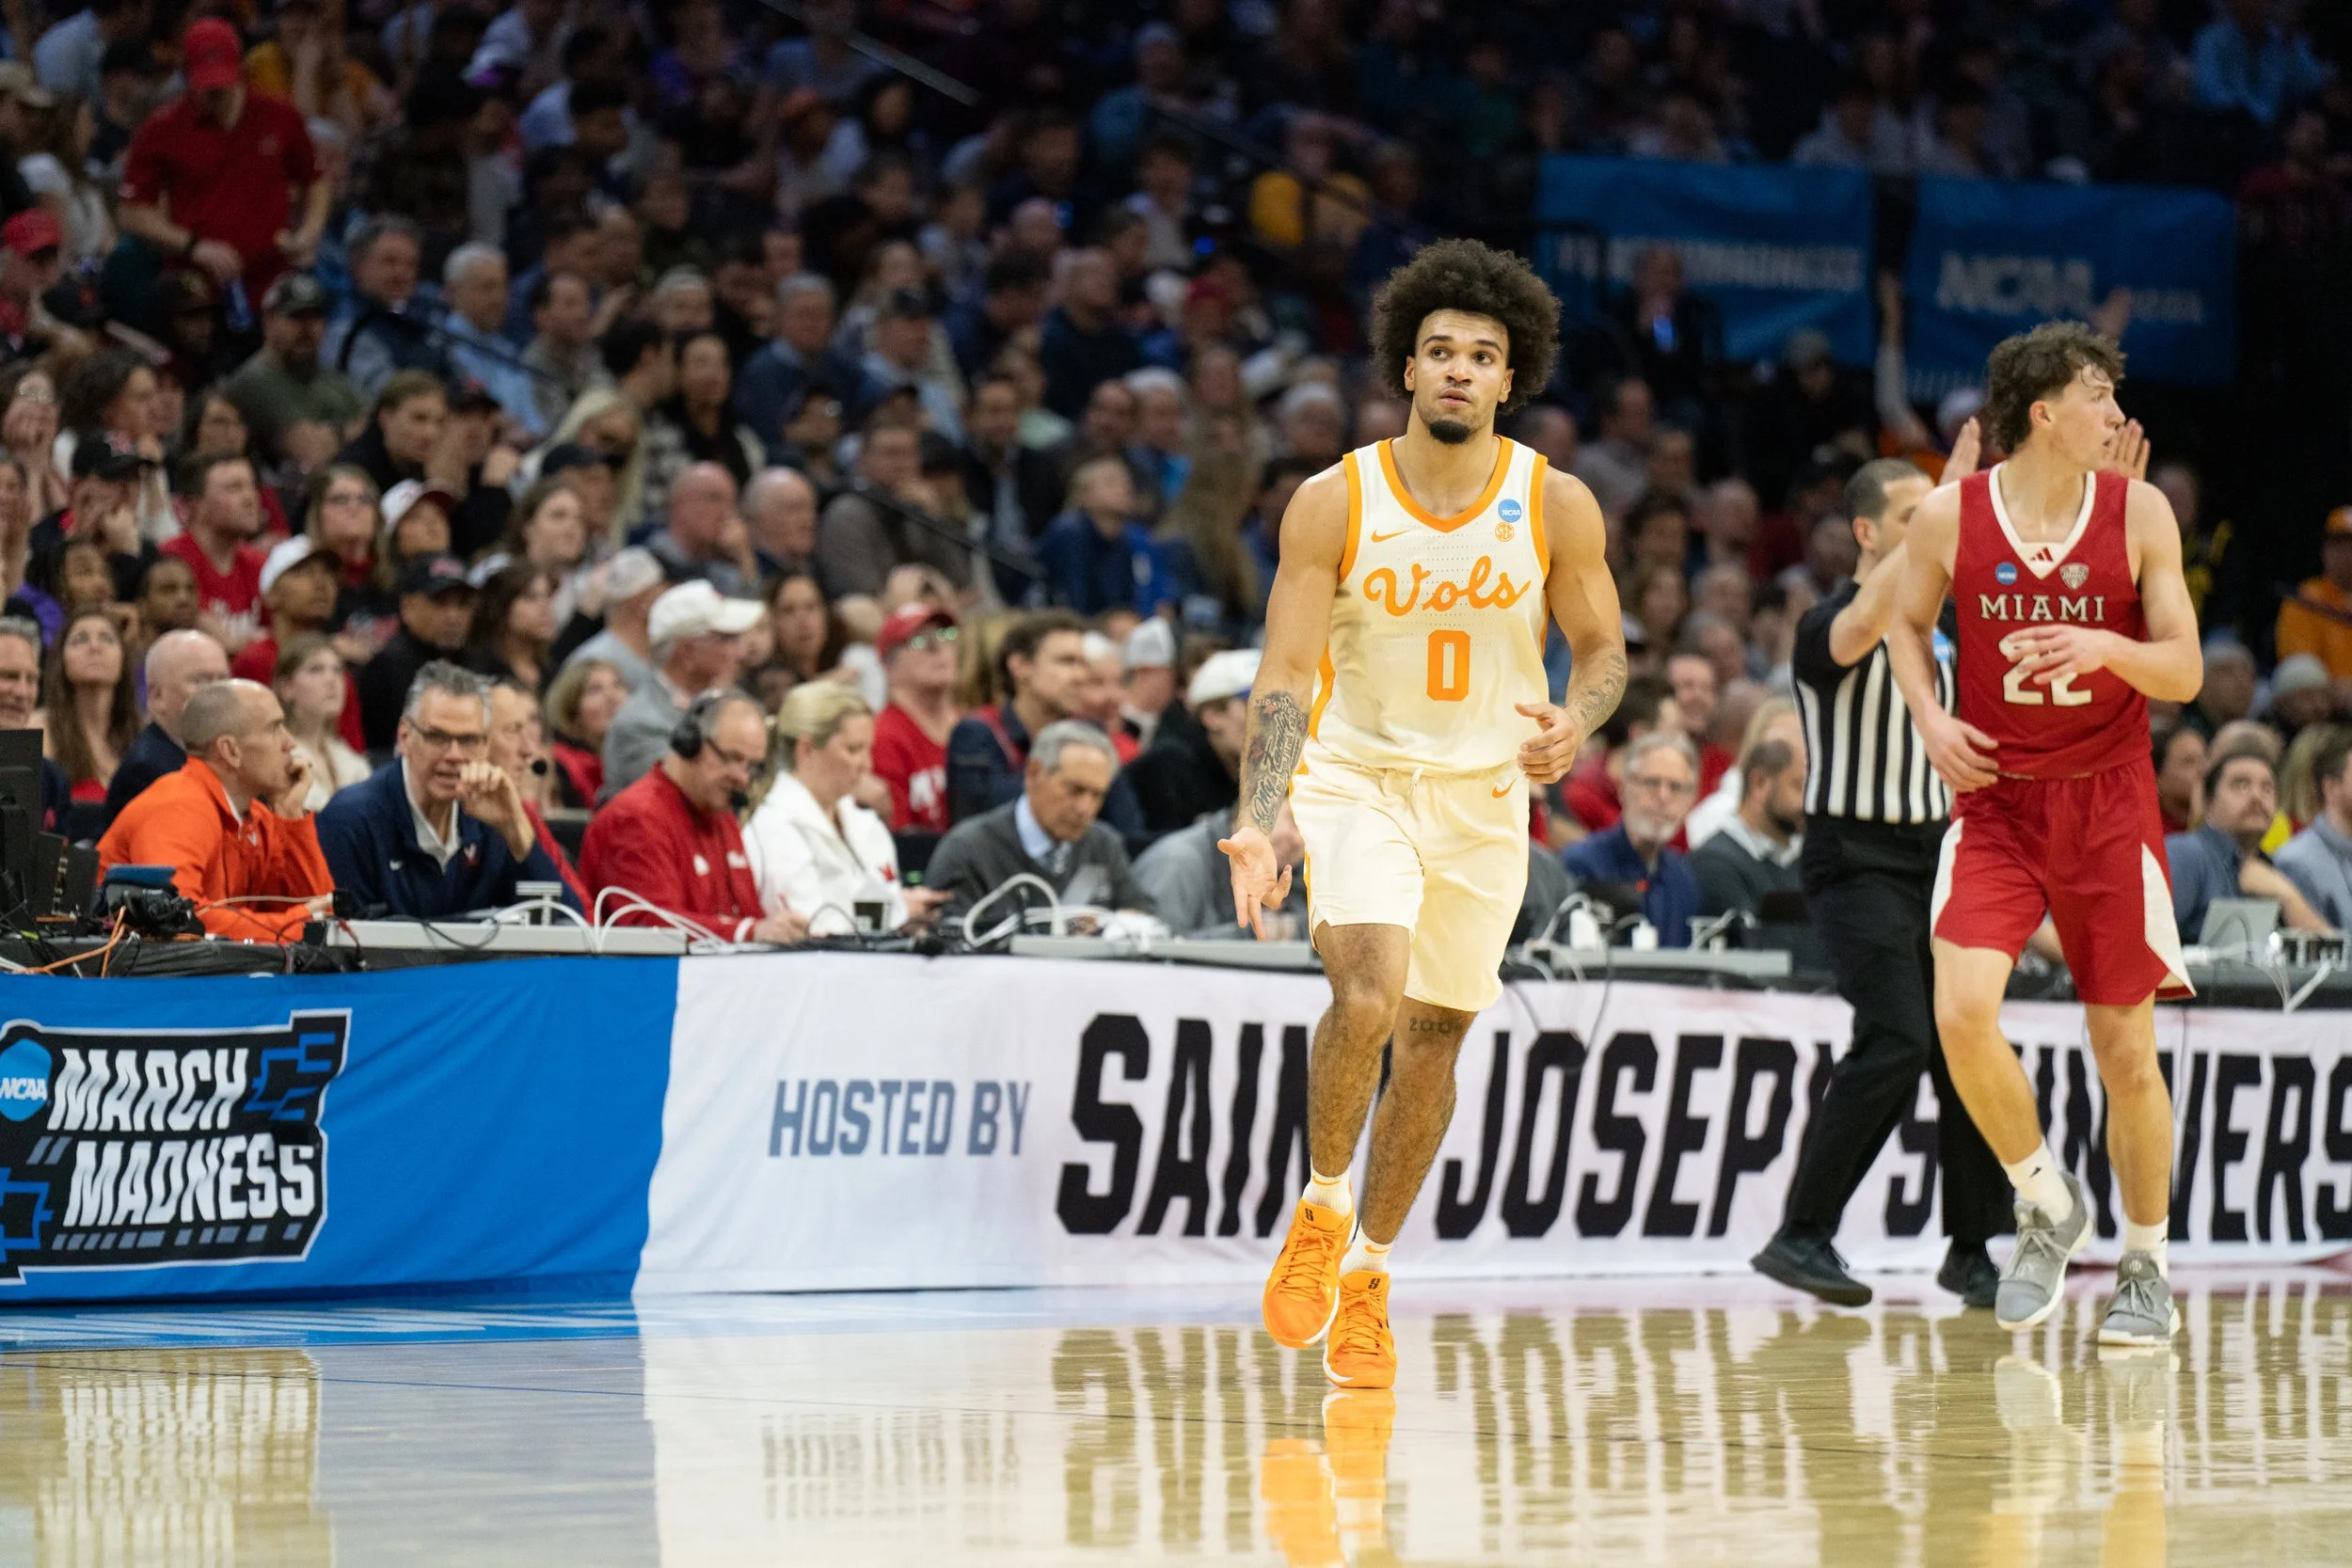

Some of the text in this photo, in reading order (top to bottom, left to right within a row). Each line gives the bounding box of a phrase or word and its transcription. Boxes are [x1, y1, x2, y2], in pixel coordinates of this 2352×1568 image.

[1363, 556, 1531, 616] Vols
[1979, 594, 2106, 622] MIAMI
[1426, 629, 1470, 702] 0
[0, 1077, 47, 1101] NCAA
[47, 1048, 248, 1132] MARCH
[768, 1080, 956, 1157] HOSTED
[966, 1082, 1031, 1157] BY
[1056, 1013, 1392, 1239] SAIN
[63, 1132, 315, 1227] MADNESS
